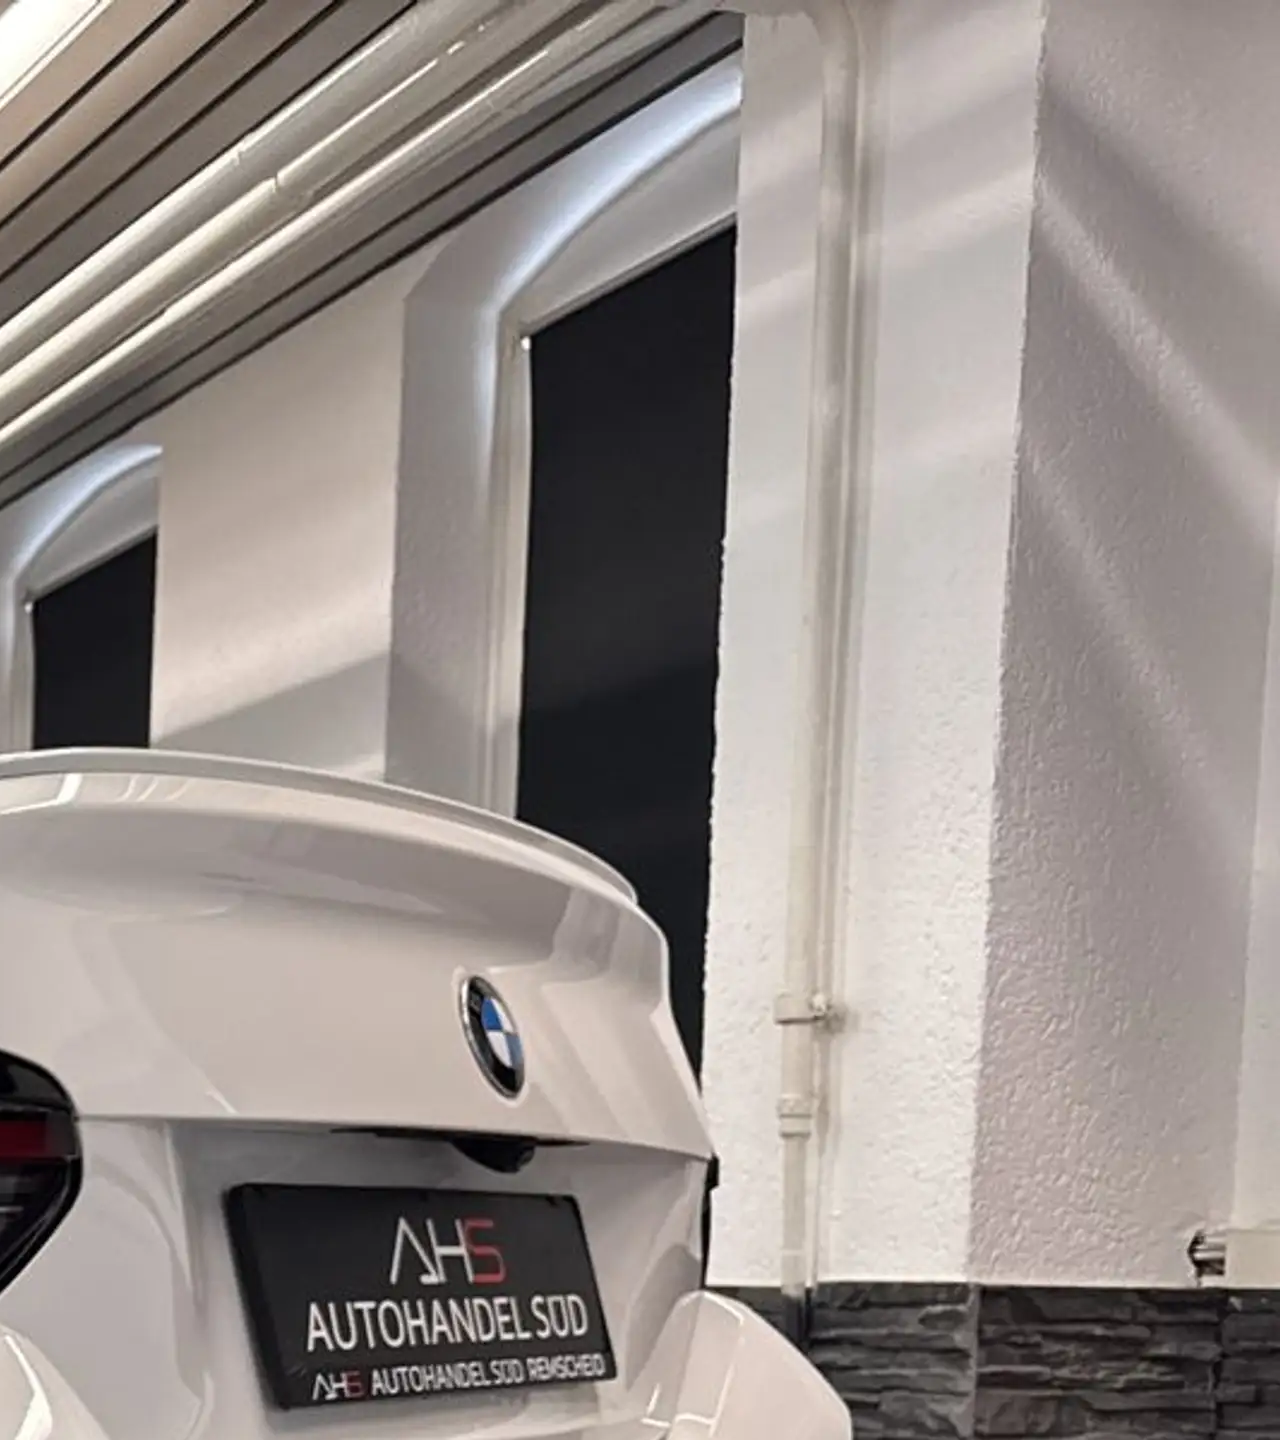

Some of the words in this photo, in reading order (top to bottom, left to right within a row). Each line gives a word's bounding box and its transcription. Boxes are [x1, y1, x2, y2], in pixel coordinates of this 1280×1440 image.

[389, 1216, 507, 1285] AHS
[306, 1297, 532, 1353] AUTOHANDEL
[370, 1362, 491, 1397] AUTOHANDEL
[526, 1353, 606, 1381] REMSCHEID
